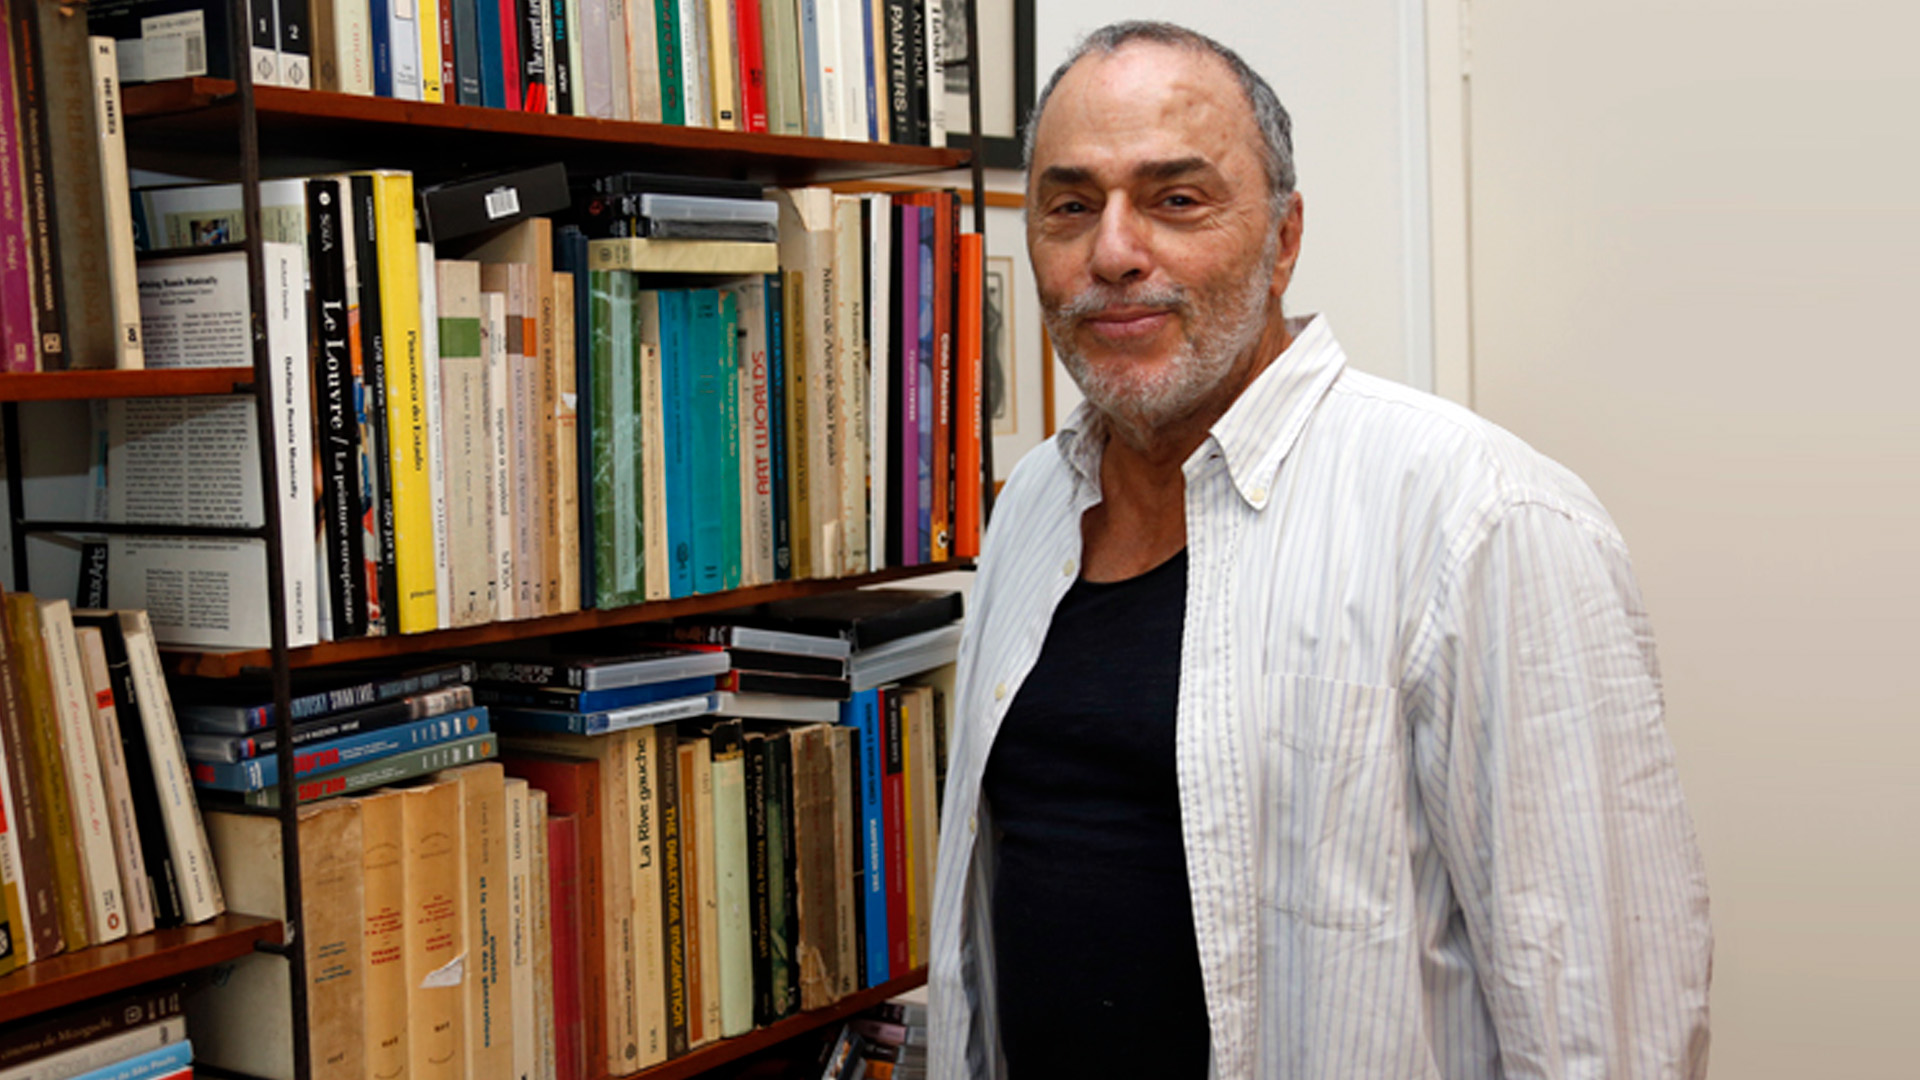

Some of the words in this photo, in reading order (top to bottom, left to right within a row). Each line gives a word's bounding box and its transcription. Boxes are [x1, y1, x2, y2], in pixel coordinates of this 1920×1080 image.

[259, 18, 268, 34] 1
[289, 24, 300, 41] 2
[554, 20, 566, 41] THE
[912, 10, 926, 88] ANTIQUE
[527, 46, 545, 76] The
[889, 4, 909, 113] PAINTERS
[822, 267, 834, 316] Museu
[321, 299, 344, 332] Le
[542, 296, 552, 345] CARLOS
[824, 317, 835, 336] de
[407, 330, 419, 402] Pinacoteca
[823, 338, 836, 371] Arte
[940, 332, 950, 368] Cildo
[284, 355, 294, 404] Defining
[324, 338, 346, 430] Louvre
[751, 350, 768, 450] WORLDS
[825, 372, 836, 391] de
[286, 407, 297, 444] Russia
[825, 392, 837, 420] São
[334, 451, 349, 471] La
[412, 424, 424, 472] Estado
[826, 422, 839, 467] Paulo
[288, 446, 299, 499] Musically
[498, 469, 509, 517] projetos
[754, 455, 770, 496] ART
[333, 474, 352, 537] peinture
[338, 539, 358, 625] européenne
[634, 737, 653, 801] gauche
[636, 804, 651, 842] Rive
[665, 805, 678, 838] THE
[754, 775, 765, 836] THOMPSON
[638, 844, 652, 870] La
[665, 839, 682, 923] DIALECTICAL
[669, 924, 685, 1028] IMAGINATION
